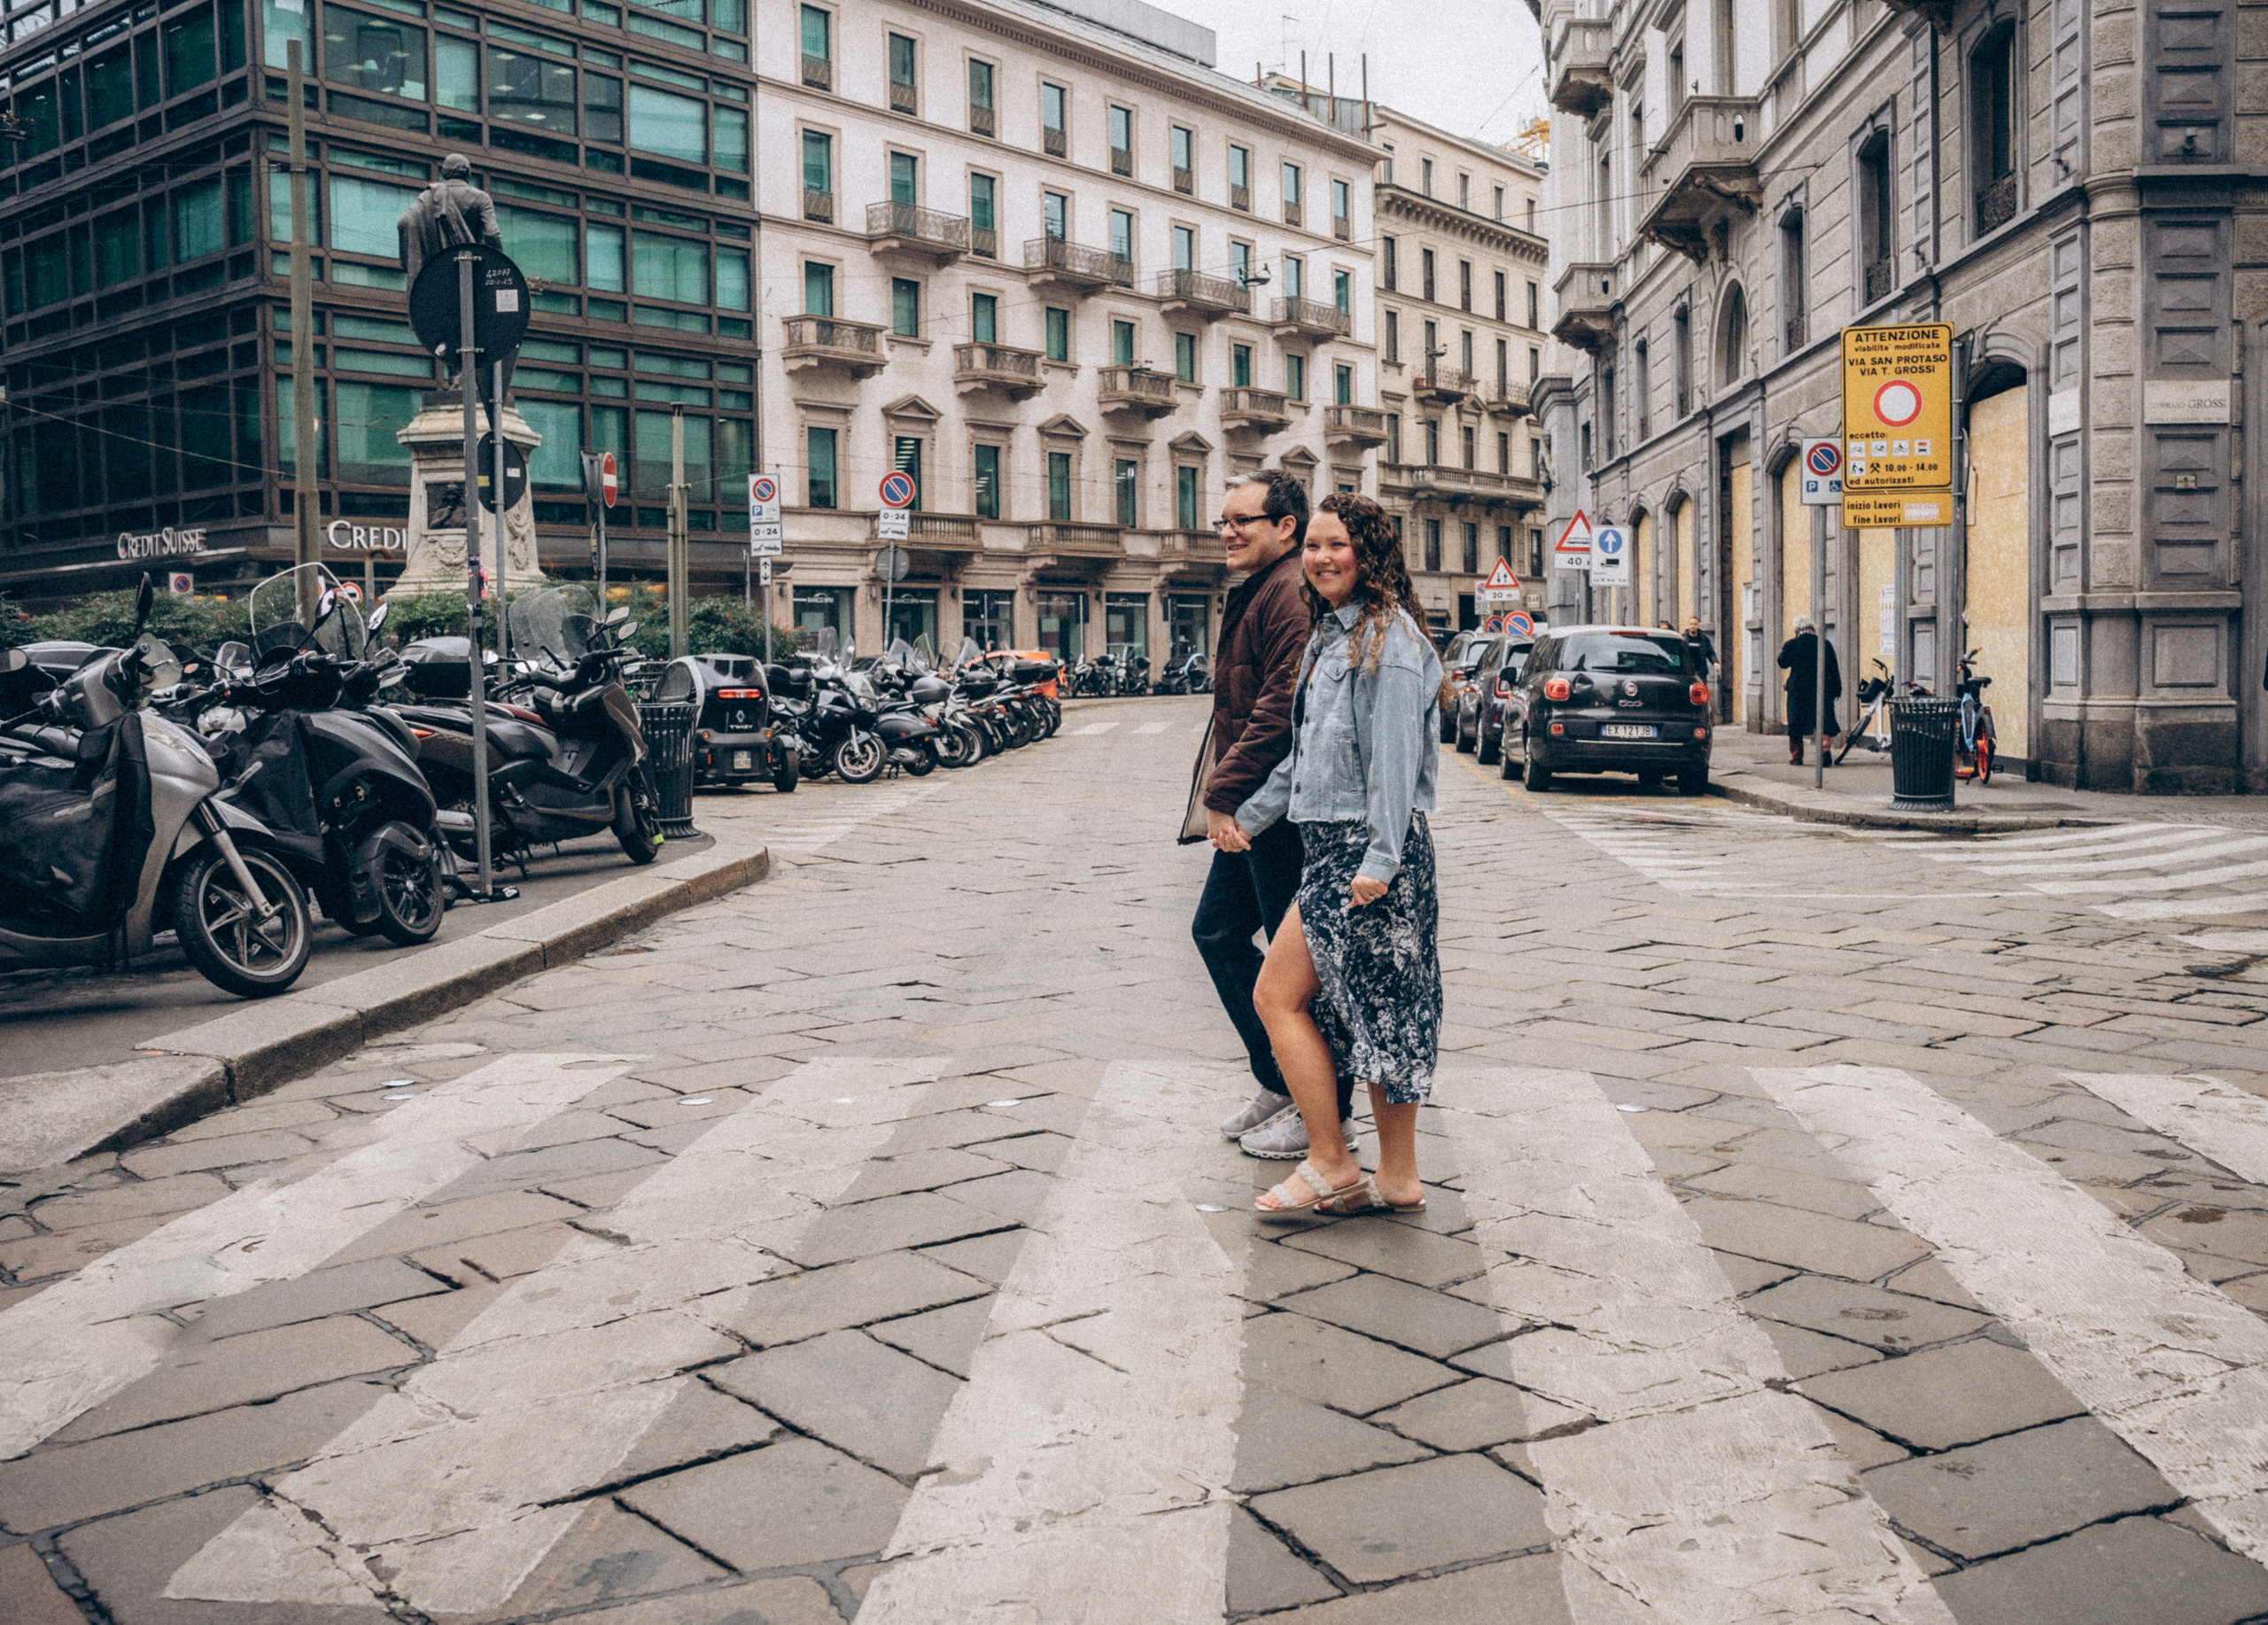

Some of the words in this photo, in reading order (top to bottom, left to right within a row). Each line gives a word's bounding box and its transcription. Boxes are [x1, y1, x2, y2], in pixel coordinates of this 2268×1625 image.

[1855, 329, 1939, 342] ATTENZIONE
[1854, 343, 1891, 352] viabilita'
[1894, 341, 1940, 351] modificata
[1848, 357, 1866, 366] VIA
[1870, 356, 1892, 365] SAN
[1897, 354, 1947, 364] PROTASO
[1860, 367, 1877, 376] VIA
[1894, 365, 1935, 375] GROSSI
[2187, 398, 2226, 408] GROSSI
[1885, 463, 1907, 472] 10.00
[1916, 463, 1938, 471] 14.00
[1846, 501, 1871, 509] inizio
[1874, 500, 1900, 509] lavori
[1852, 515, 1871, 524] fine
[1874, 514, 1900, 524] lavori
[328, 519, 407, 549] CREDI
[117, 532, 161, 559] CREDIT
[162, 527, 206, 555] SUISSE
[1567, 556, 1582, 565] 40
[1607, 726, 1619, 735] EX
